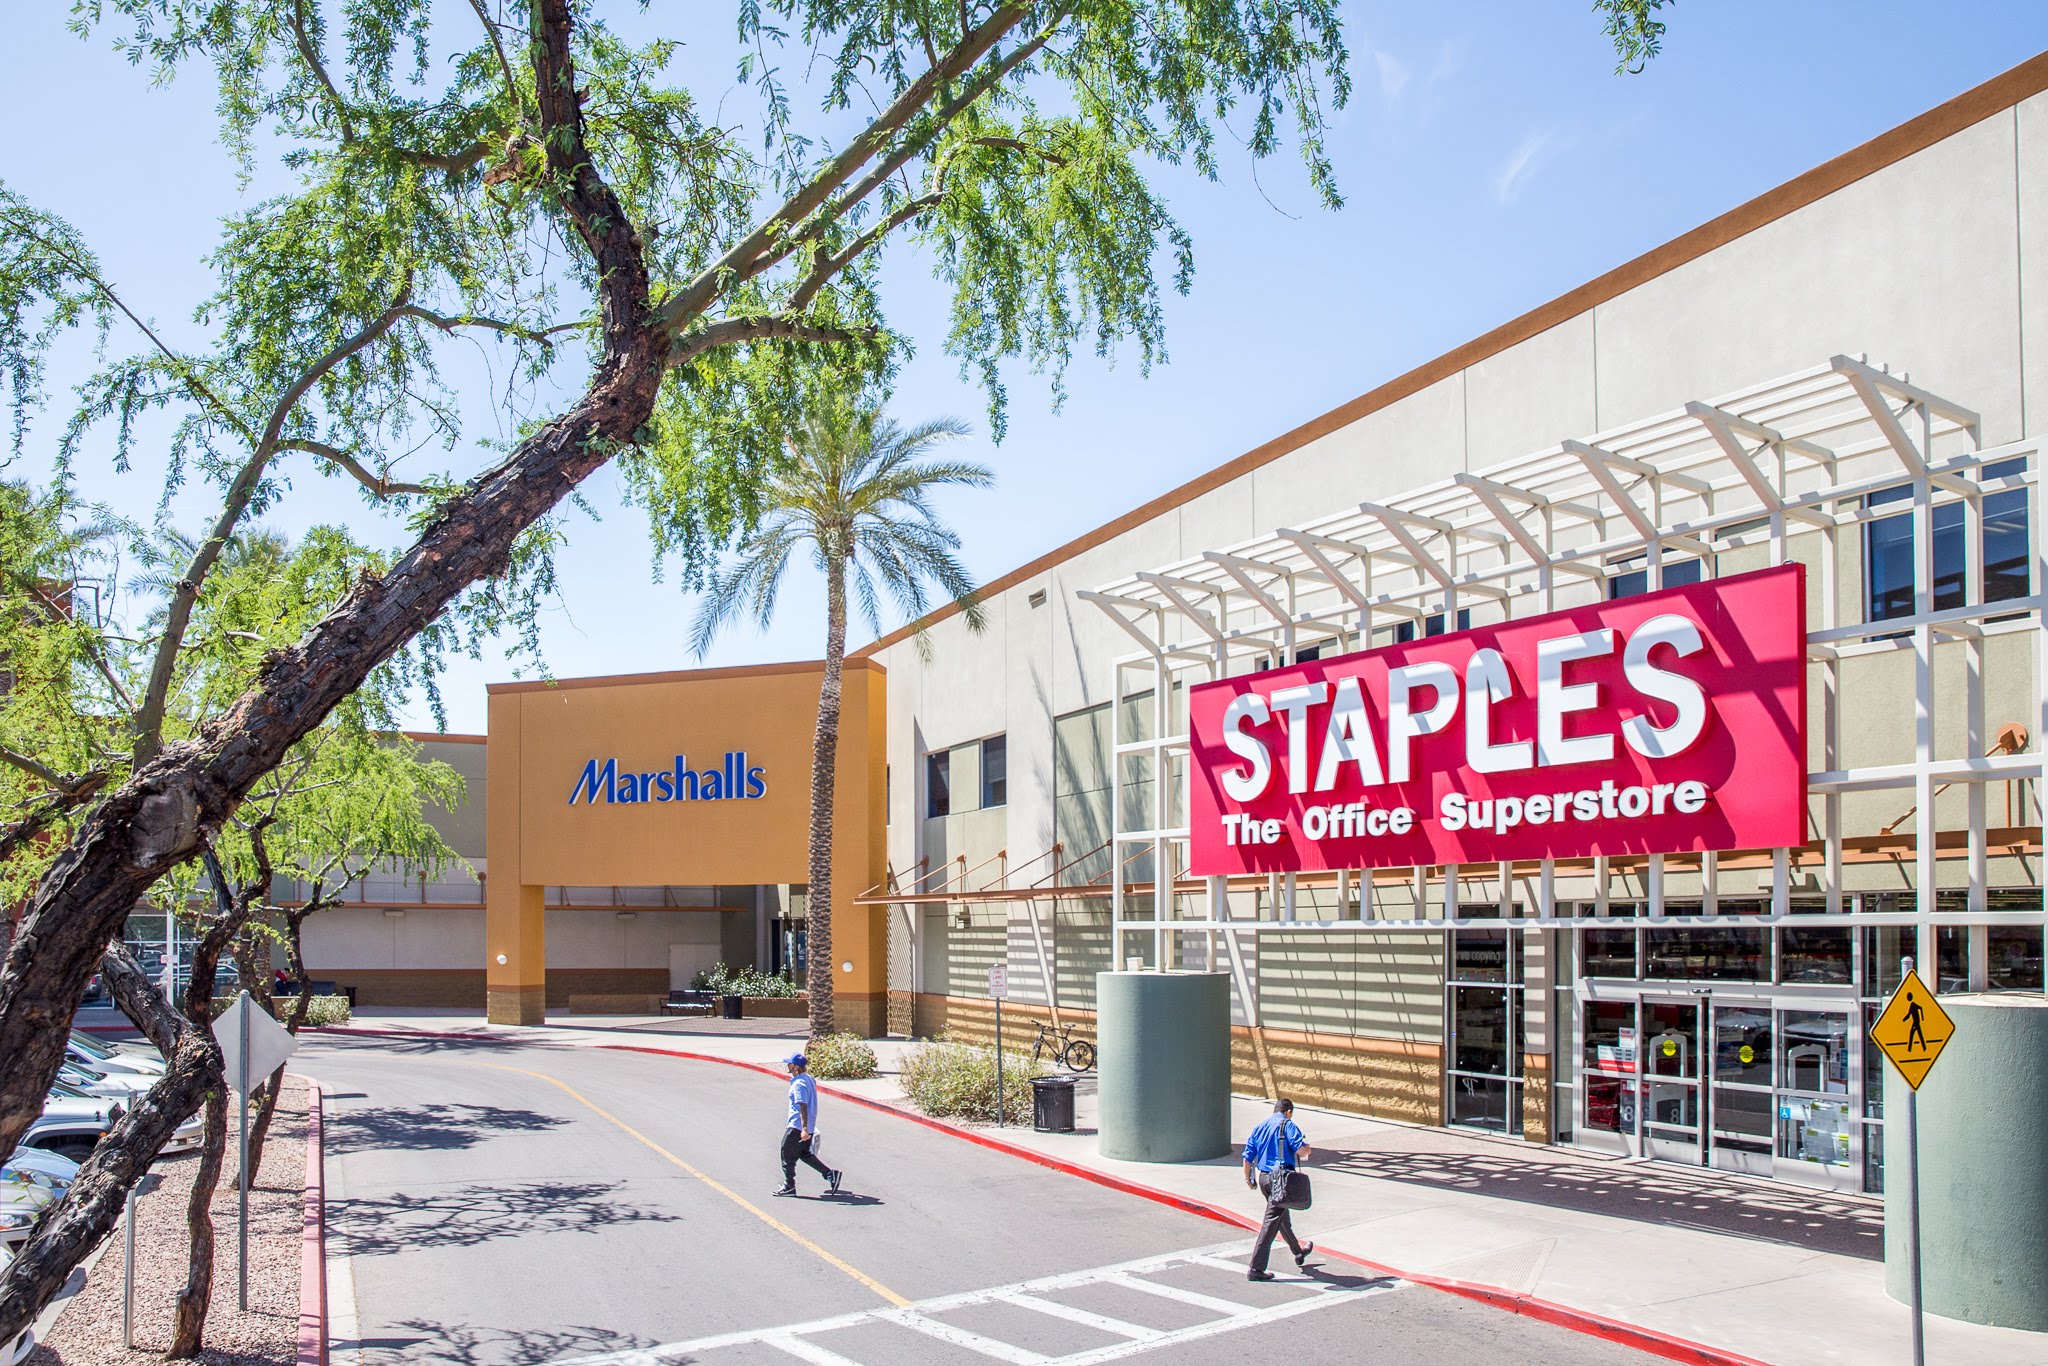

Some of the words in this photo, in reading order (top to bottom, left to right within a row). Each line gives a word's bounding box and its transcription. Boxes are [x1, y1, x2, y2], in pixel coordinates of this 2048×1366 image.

[1221, 614, 1707, 803] STAPLES
[568, 751, 767, 805] Marshalls
[1222, 813, 1285, 846] The
[1302, 802, 1417, 841] Office
[1440, 779, 1709, 835] Superstore
[1471, 949, 1501, 964] copying
